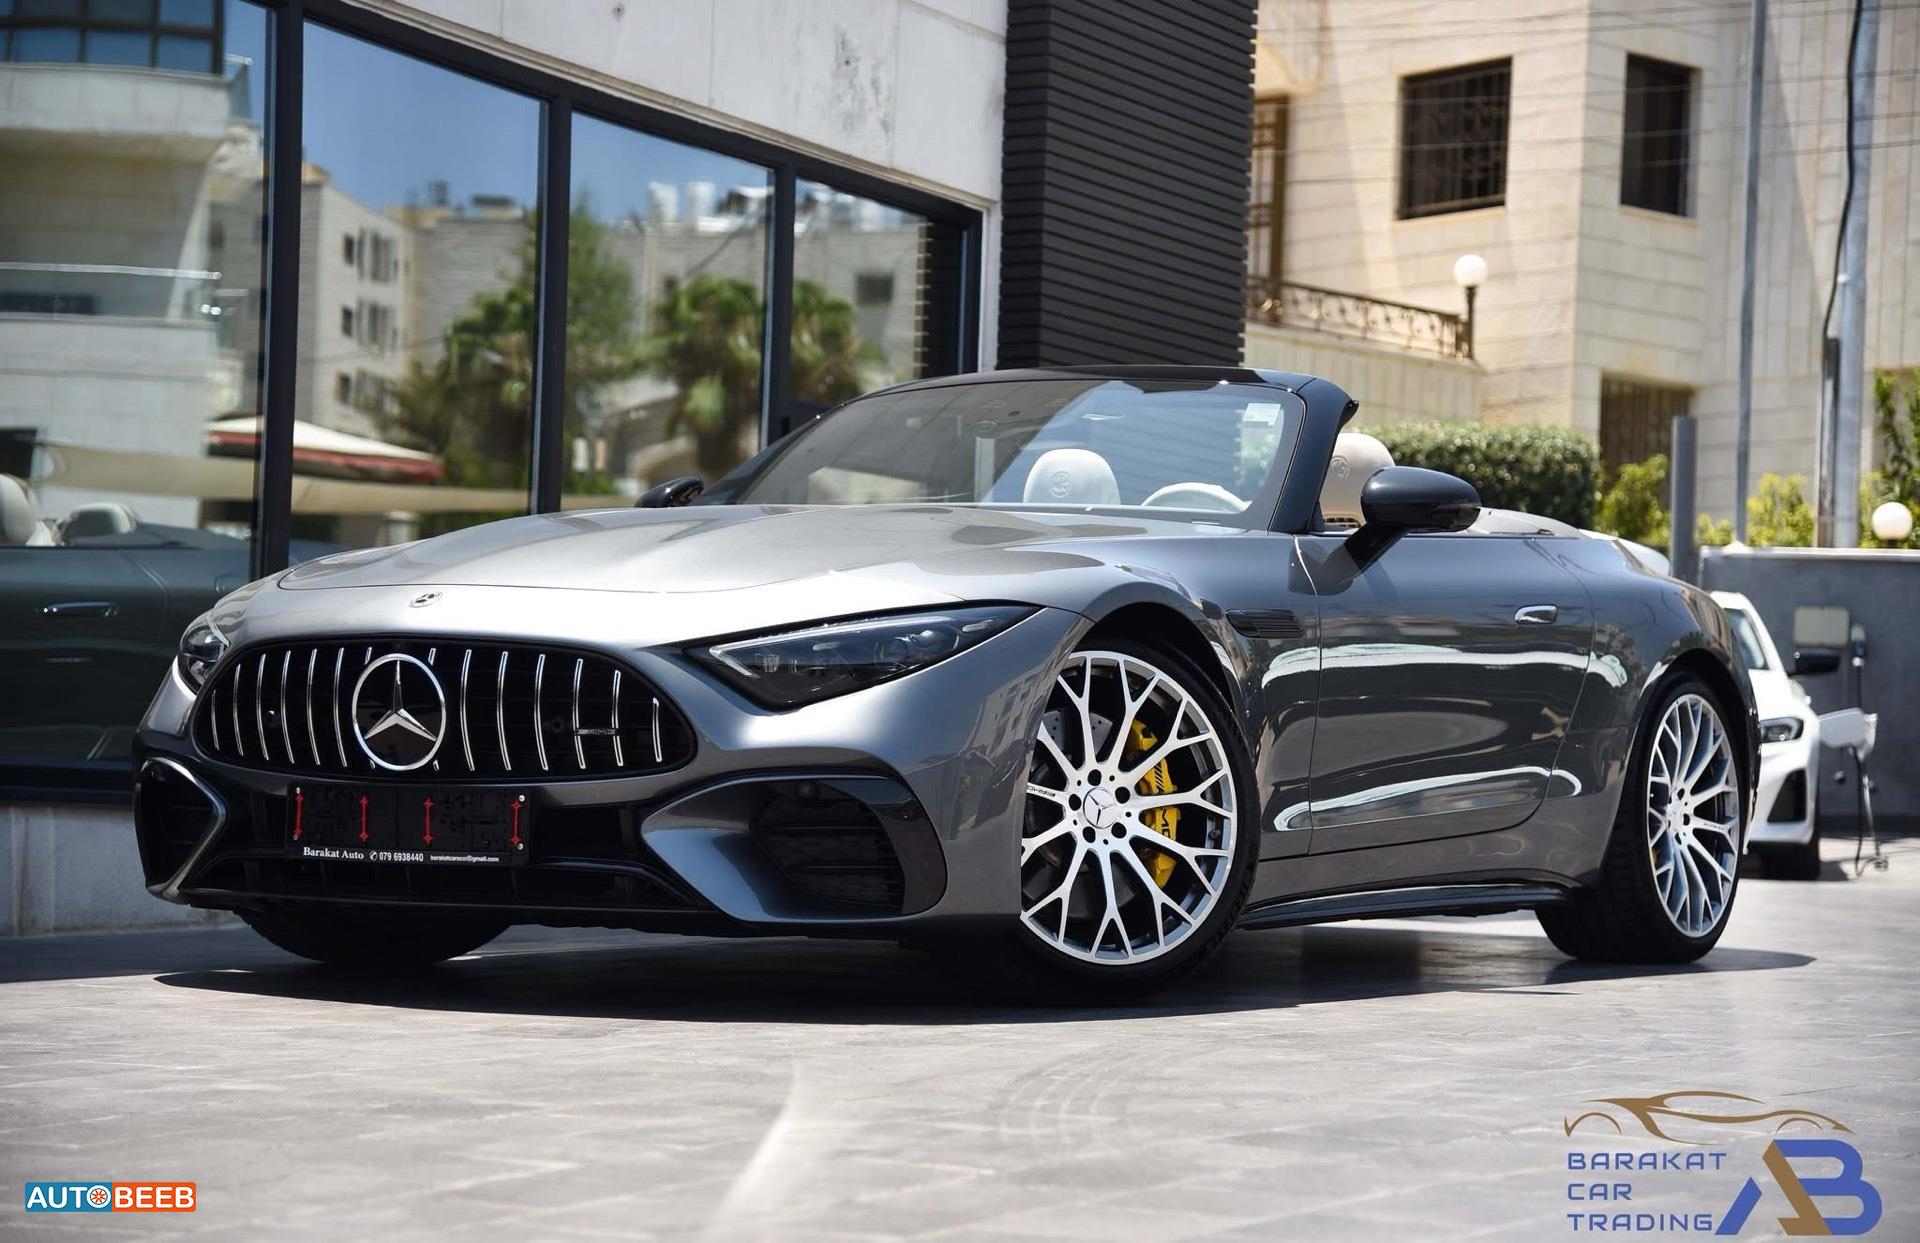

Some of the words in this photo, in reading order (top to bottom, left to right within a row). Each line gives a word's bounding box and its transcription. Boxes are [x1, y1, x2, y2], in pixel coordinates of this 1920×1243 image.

[303, 846, 339, 858] Barakat
[341, 850, 364, 860] Auto
[379, 851, 392, 861] 079
[393, 852, 424, 862] 6938440
